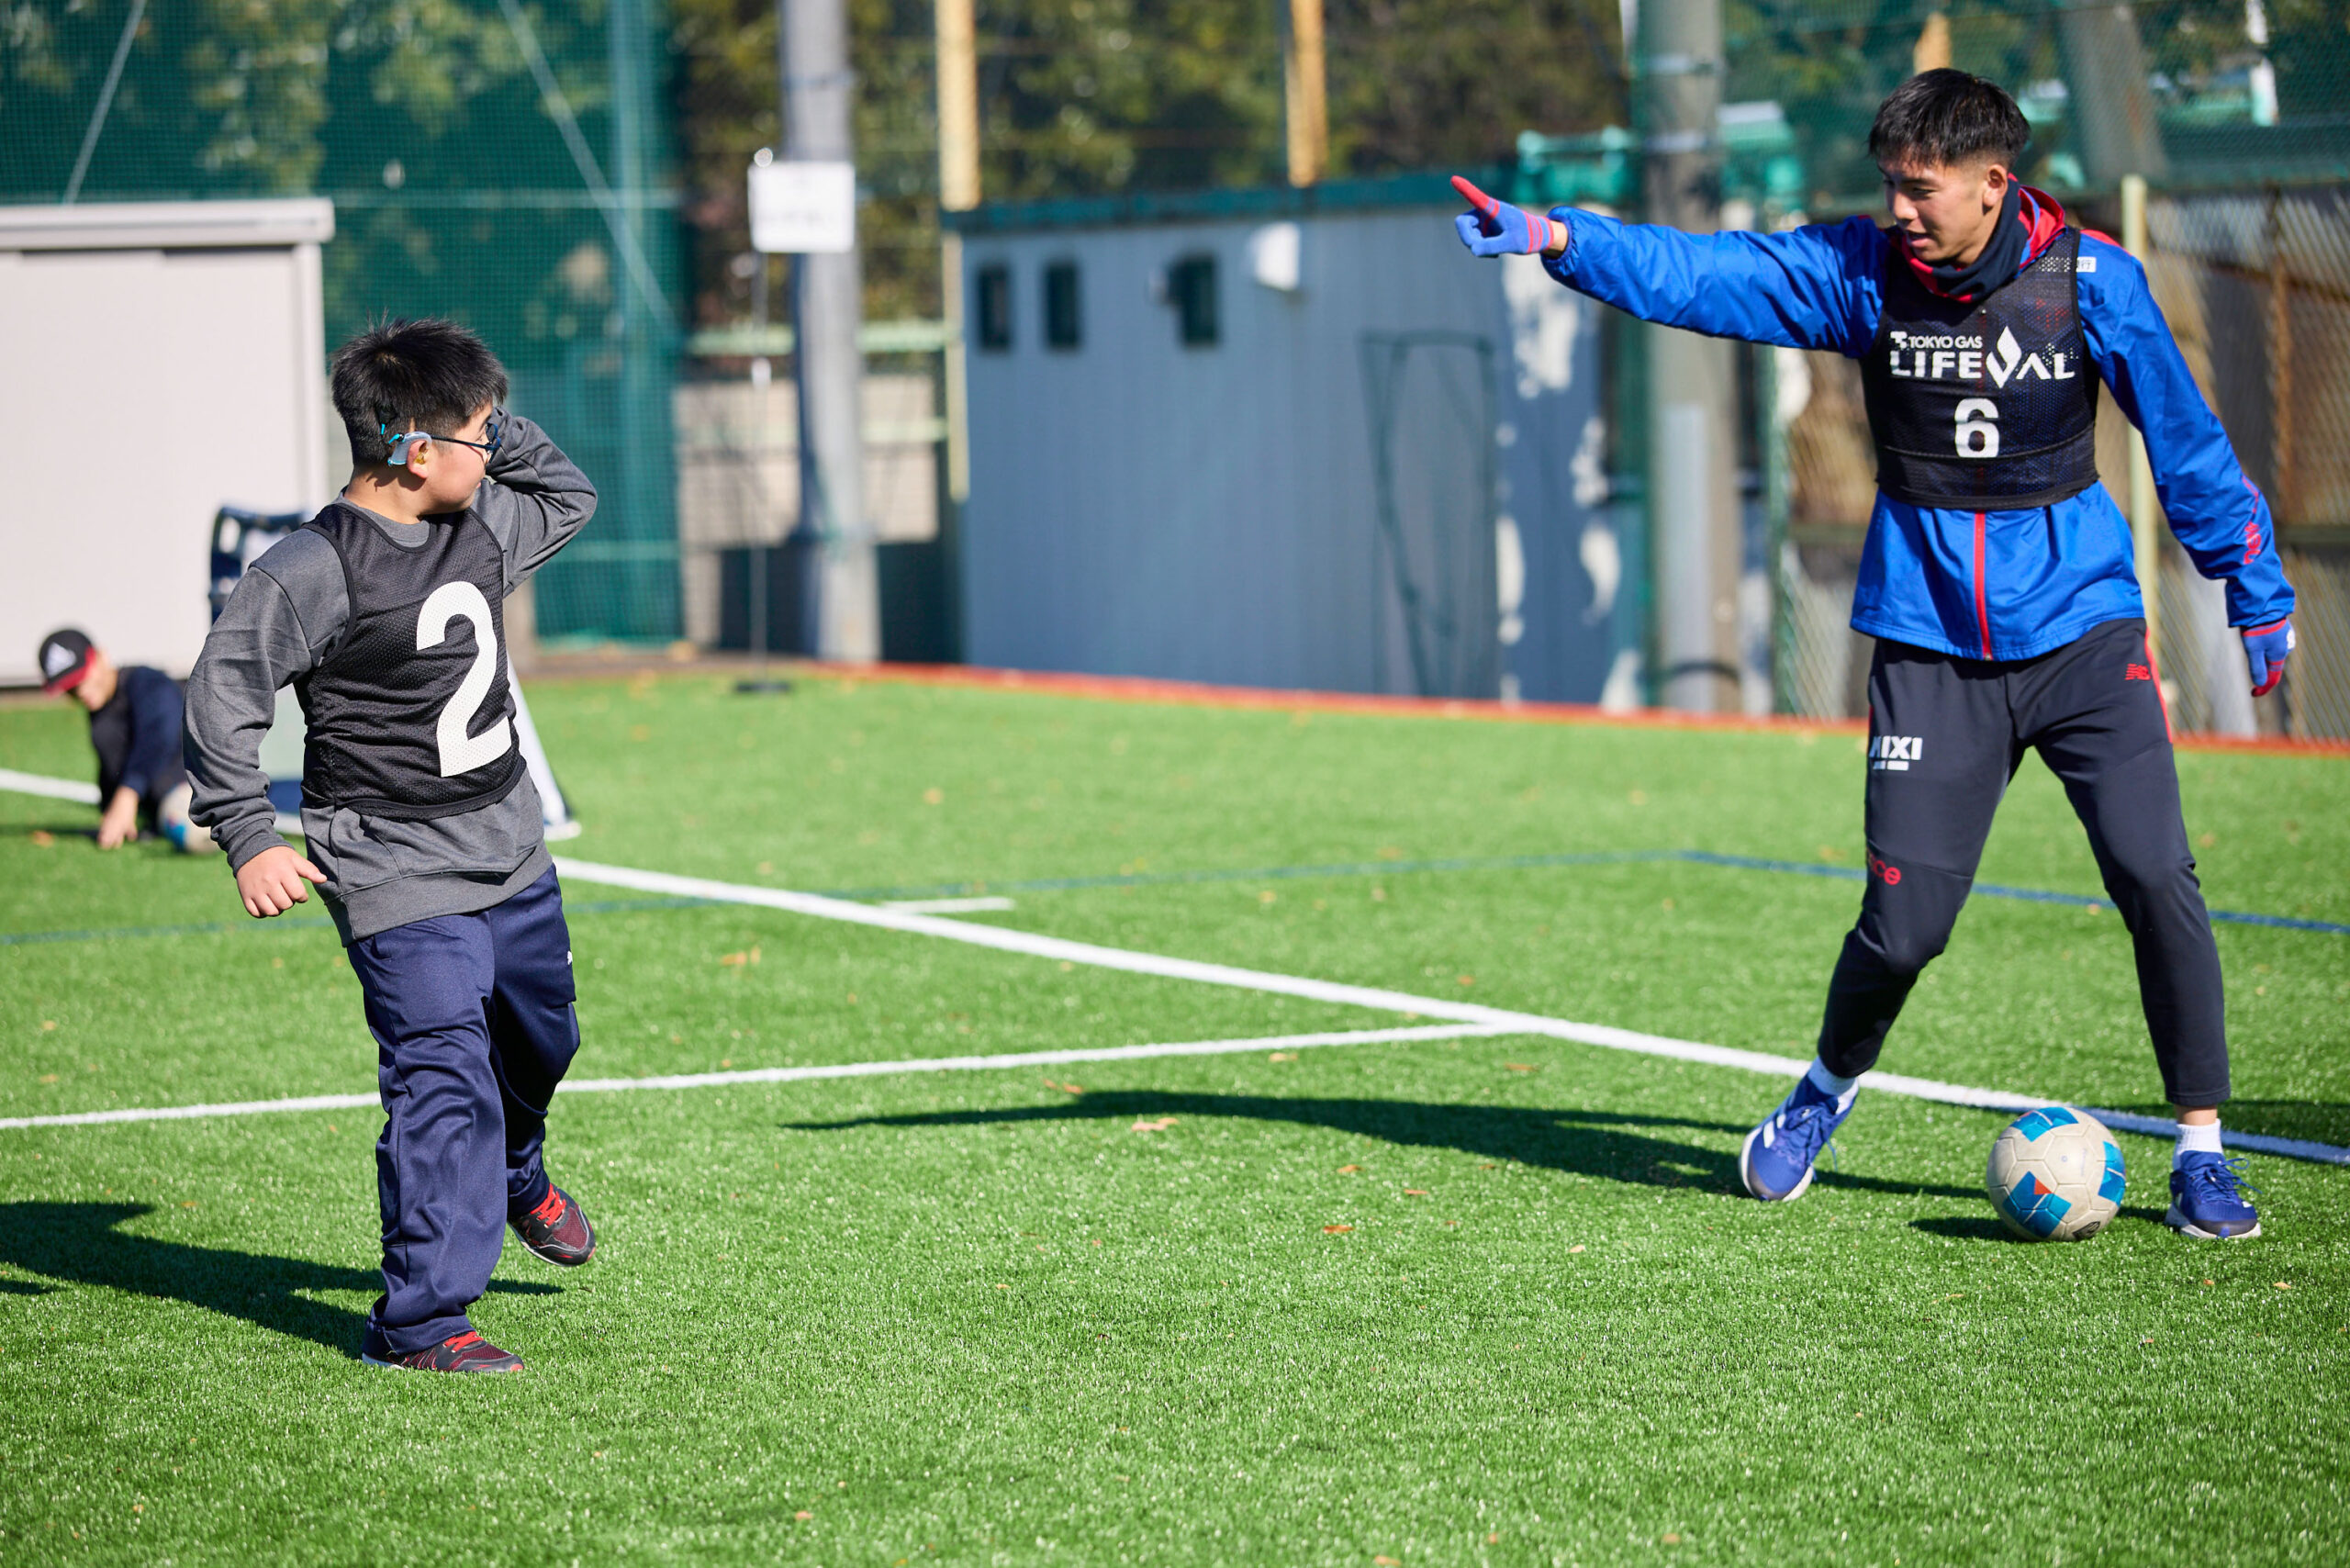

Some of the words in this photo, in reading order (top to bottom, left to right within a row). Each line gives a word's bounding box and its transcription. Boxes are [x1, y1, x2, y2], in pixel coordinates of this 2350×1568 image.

[1908, 336, 1953, 349] TOKYO
[1954, 335, 1983, 349] GAS
[1954, 398, 2000, 459] 6
[416, 580, 513, 778] 2
